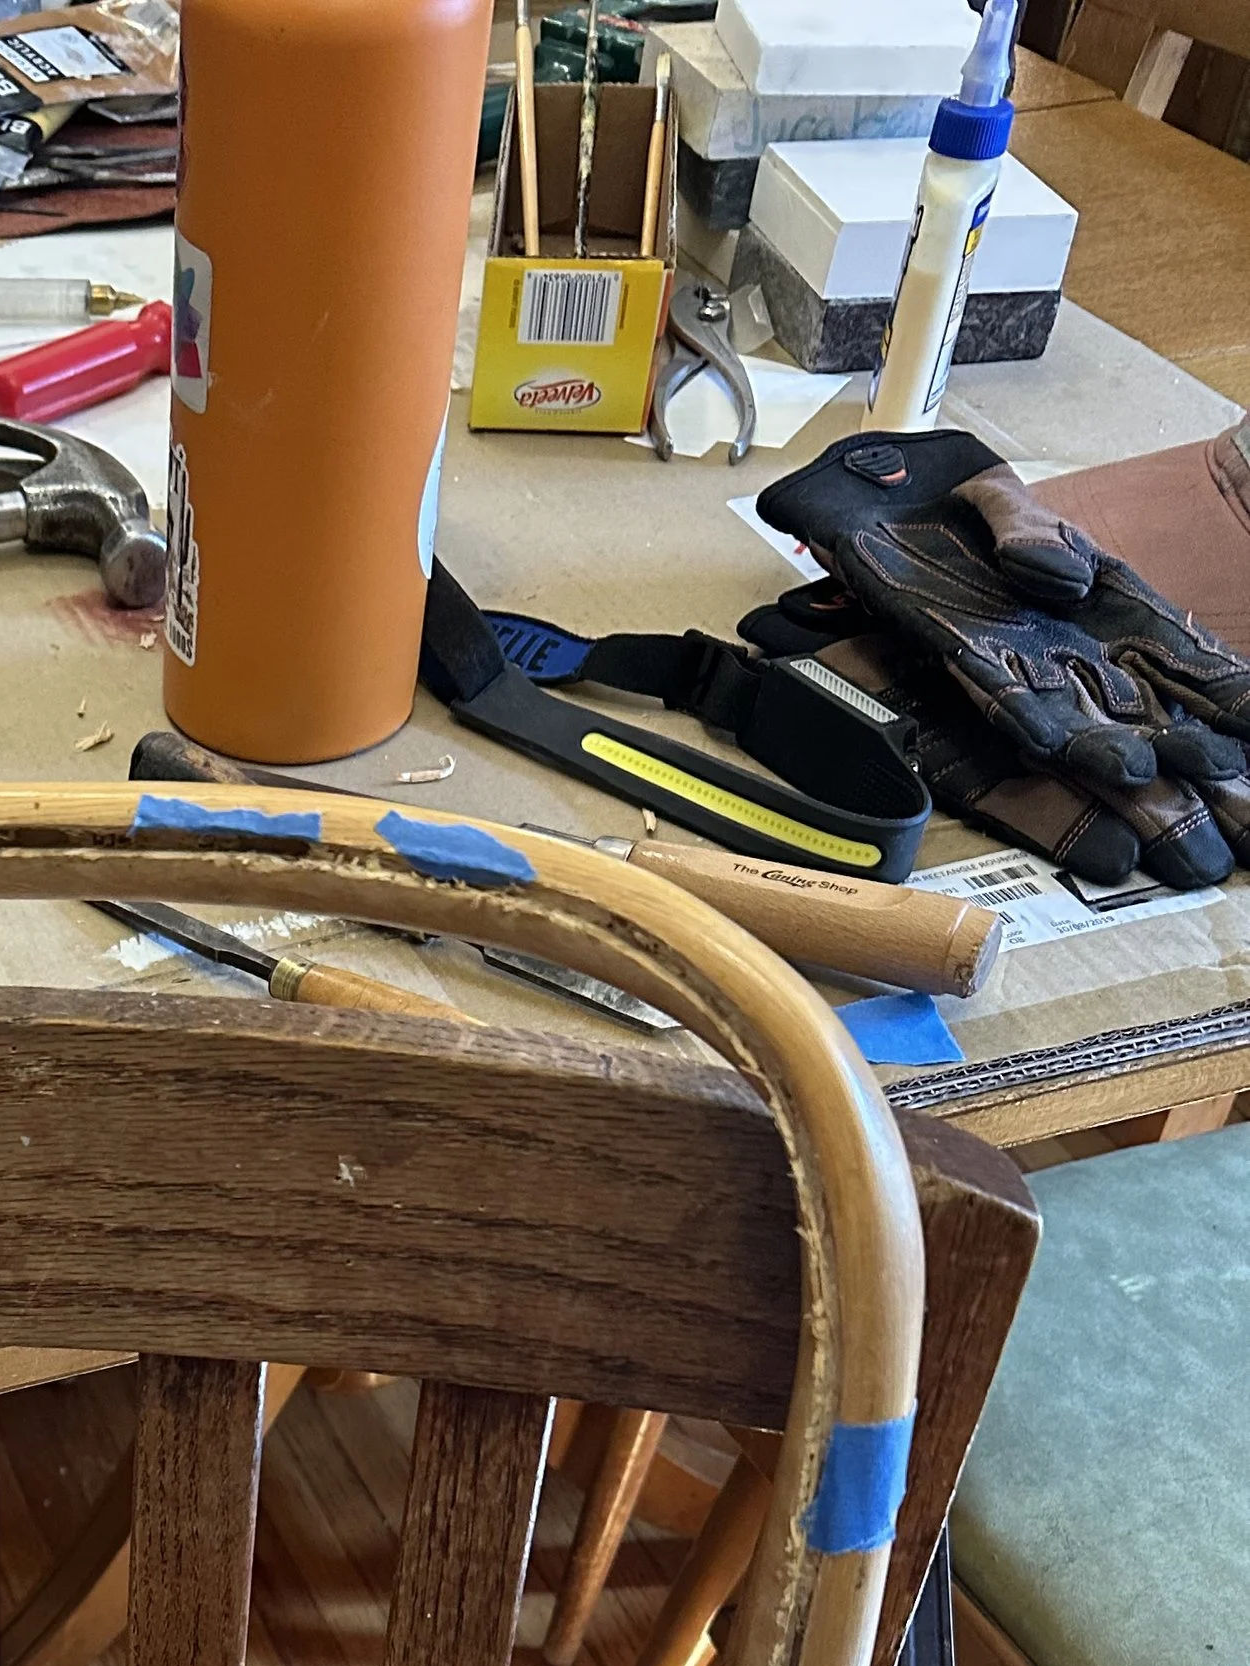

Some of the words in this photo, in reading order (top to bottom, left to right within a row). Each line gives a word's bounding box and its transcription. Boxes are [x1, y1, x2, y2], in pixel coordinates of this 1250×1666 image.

[518, 382, 596, 409] Velveeta
[732, 863, 759, 875] The
[761, 869, 818, 889] Caning
[817, 880, 859, 896] Shop
[921, 863, 979, 883] RECTANGLE
